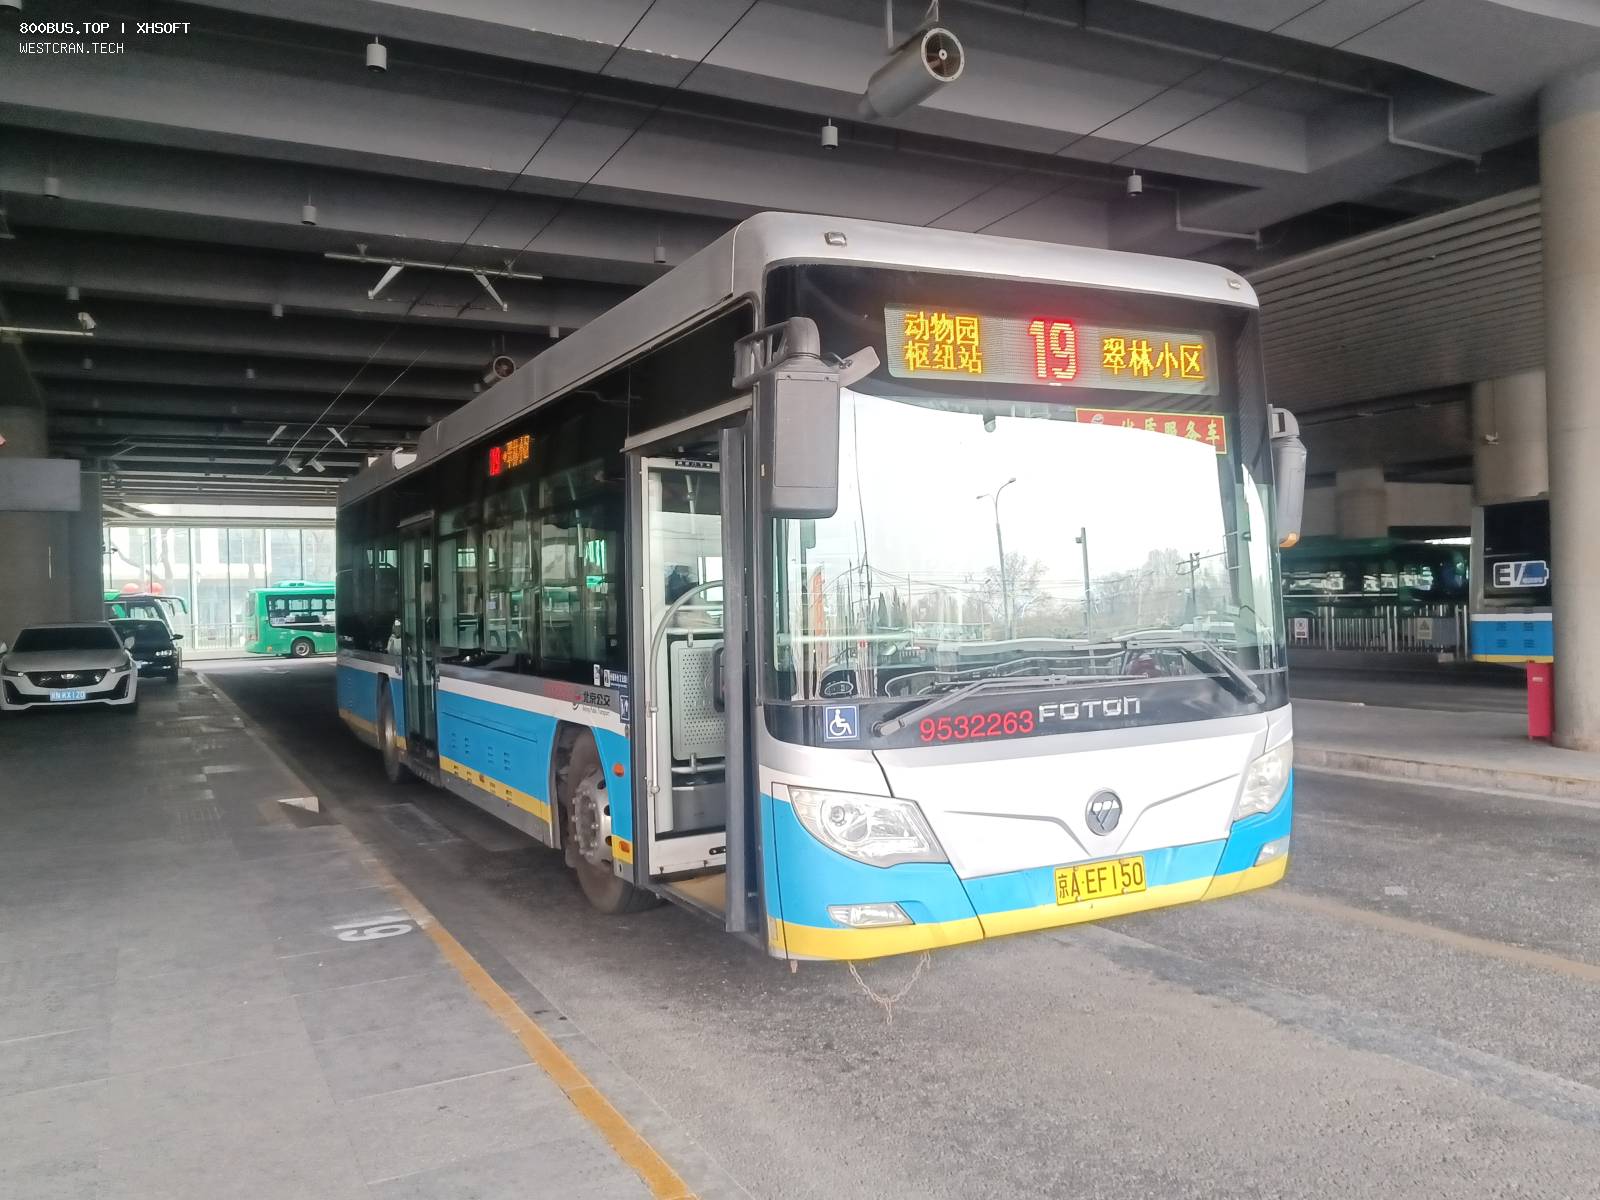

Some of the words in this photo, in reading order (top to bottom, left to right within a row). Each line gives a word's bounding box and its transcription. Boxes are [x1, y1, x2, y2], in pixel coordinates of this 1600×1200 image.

[904, 311, 979, 345] 动物园
[904, 341, 982, 374] 枢纽站
[1028, 320, 1077, 379] 19
[1103, 337, 1204, 379] 翠林小区
[919, 710, 1034, 742] 9532263
[1039, 696, 1141, 723] FOTON
